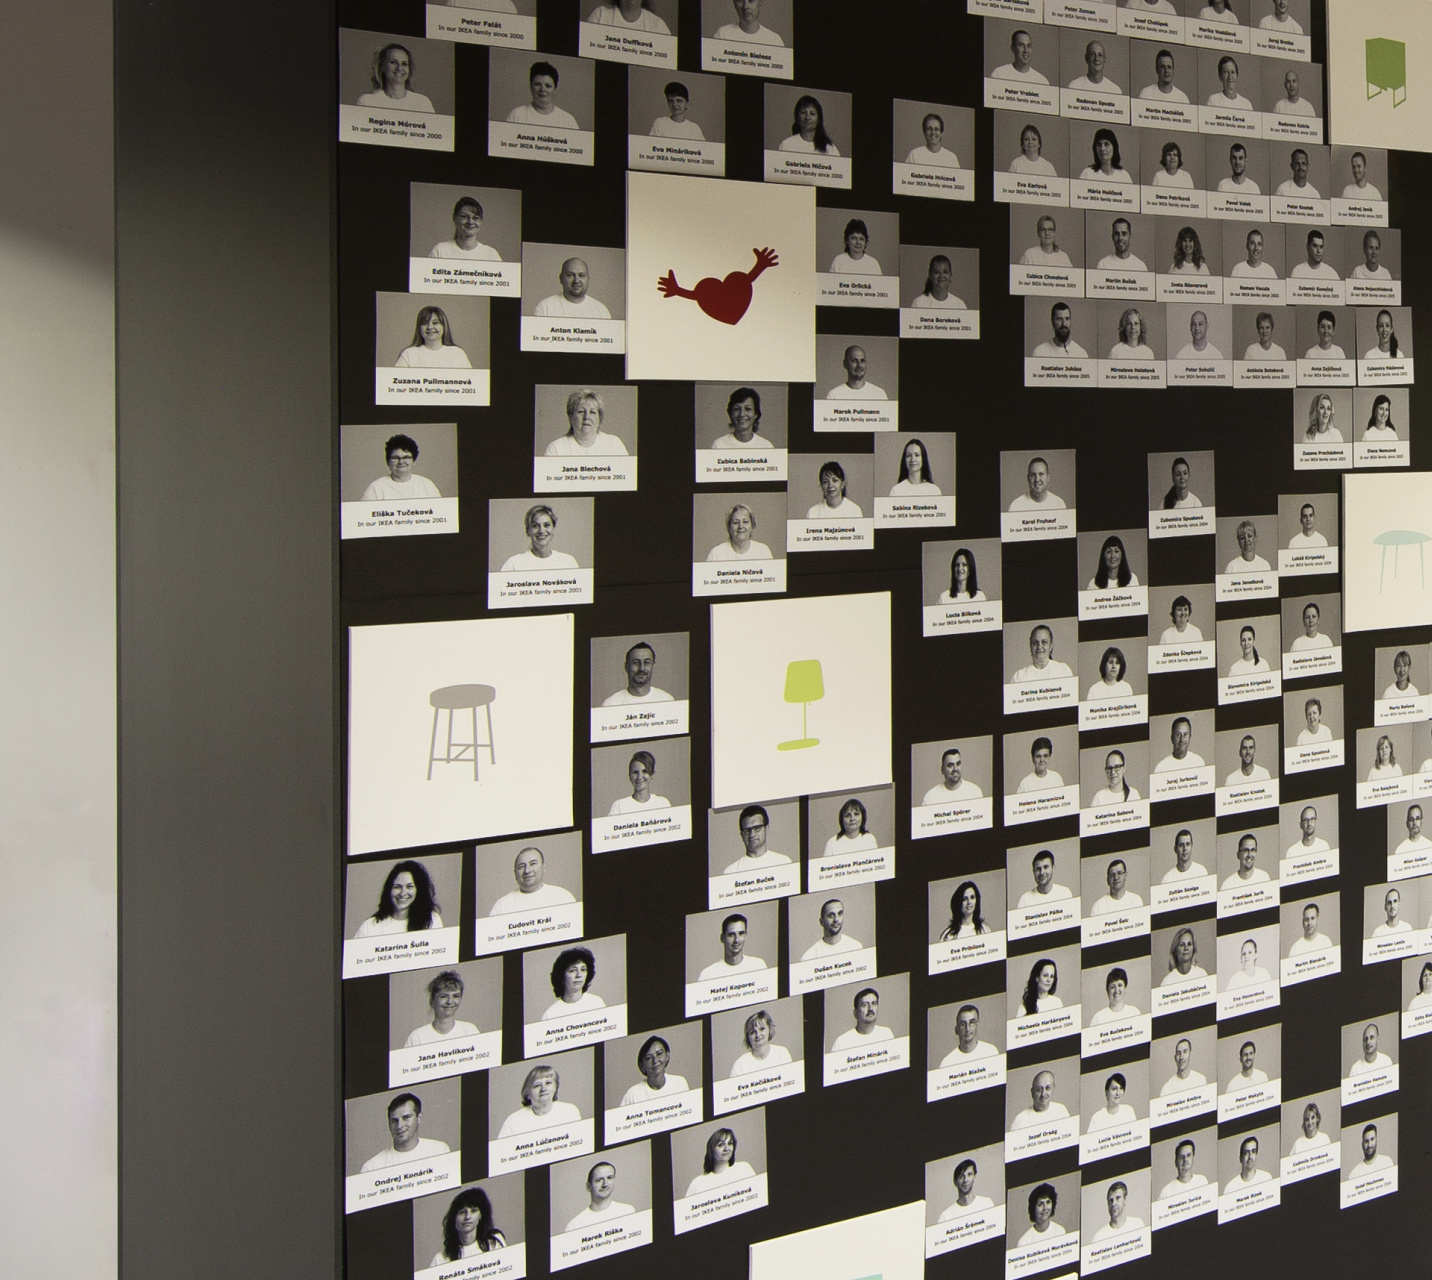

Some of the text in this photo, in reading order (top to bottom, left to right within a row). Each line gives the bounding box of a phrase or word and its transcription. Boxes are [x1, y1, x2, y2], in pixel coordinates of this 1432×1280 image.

[461, 18, 481, 26] Peter
[458, 26, 473, 34] IKEA
[473, 28, 492, 37] family
[368, 117, 396, 126] Regina
[389, 128, 408, 137] family
[784, 160, 811, 168] Gabriela
[459, 278, 477, 286] family
[506, 578, 576, 588] Jaroslava Nováková
[613, 822, 639, 831] Daniela
[536, 916, 551, 924] Král
[377, 954, 392, 962] IKEA
[710, 986, 728, 994] Matej
[374, 1175, 401, 1187] Ondrej
[379, 1186, 394, 1195] IKEA
[396, 1182, 415, 1190] family
[416, 1178, 432, 1186] since
[581, 1233, 602, 1243] Marek
